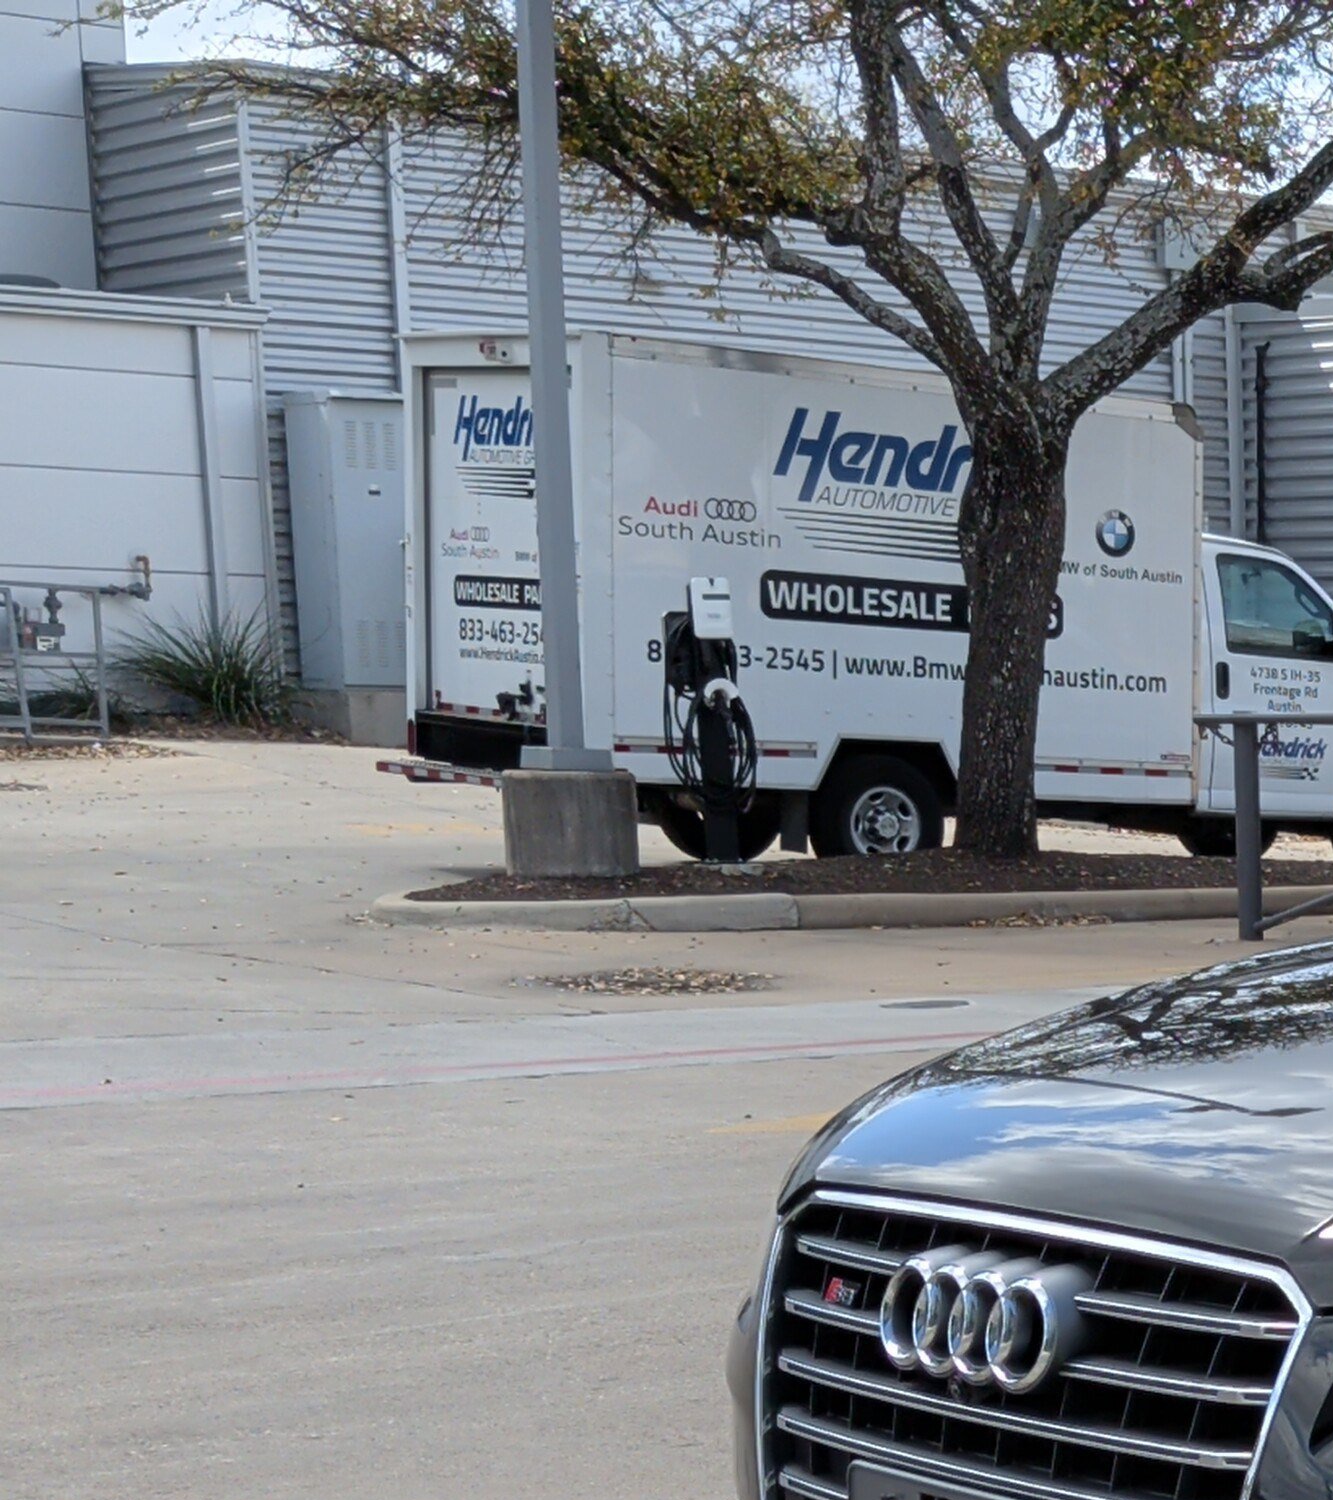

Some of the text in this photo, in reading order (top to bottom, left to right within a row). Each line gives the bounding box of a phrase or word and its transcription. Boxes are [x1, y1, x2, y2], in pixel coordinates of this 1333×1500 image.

[453, 395, 533, 462] Hendri
[773, 407, 974, 503] Hendr
[644, 496, 698, 517] Audi
[816, 486, 958, 517] AUTOMOTIVE
[449, 528, 469, 541] Audi
[618, 515, 782, 549] South Austin
[441, 543, 500, 559] South Austin
[1083, 564, 1097, 577] of
[1100, 564, 1138, 580] South
[1141, 569, 1183, 584] Austin
[456, 580, 520, 604] WHOLESALE
[766, 579, 953, 623] WHOLESALE
[1253, 682, 1319, 700] Frontage Rd
